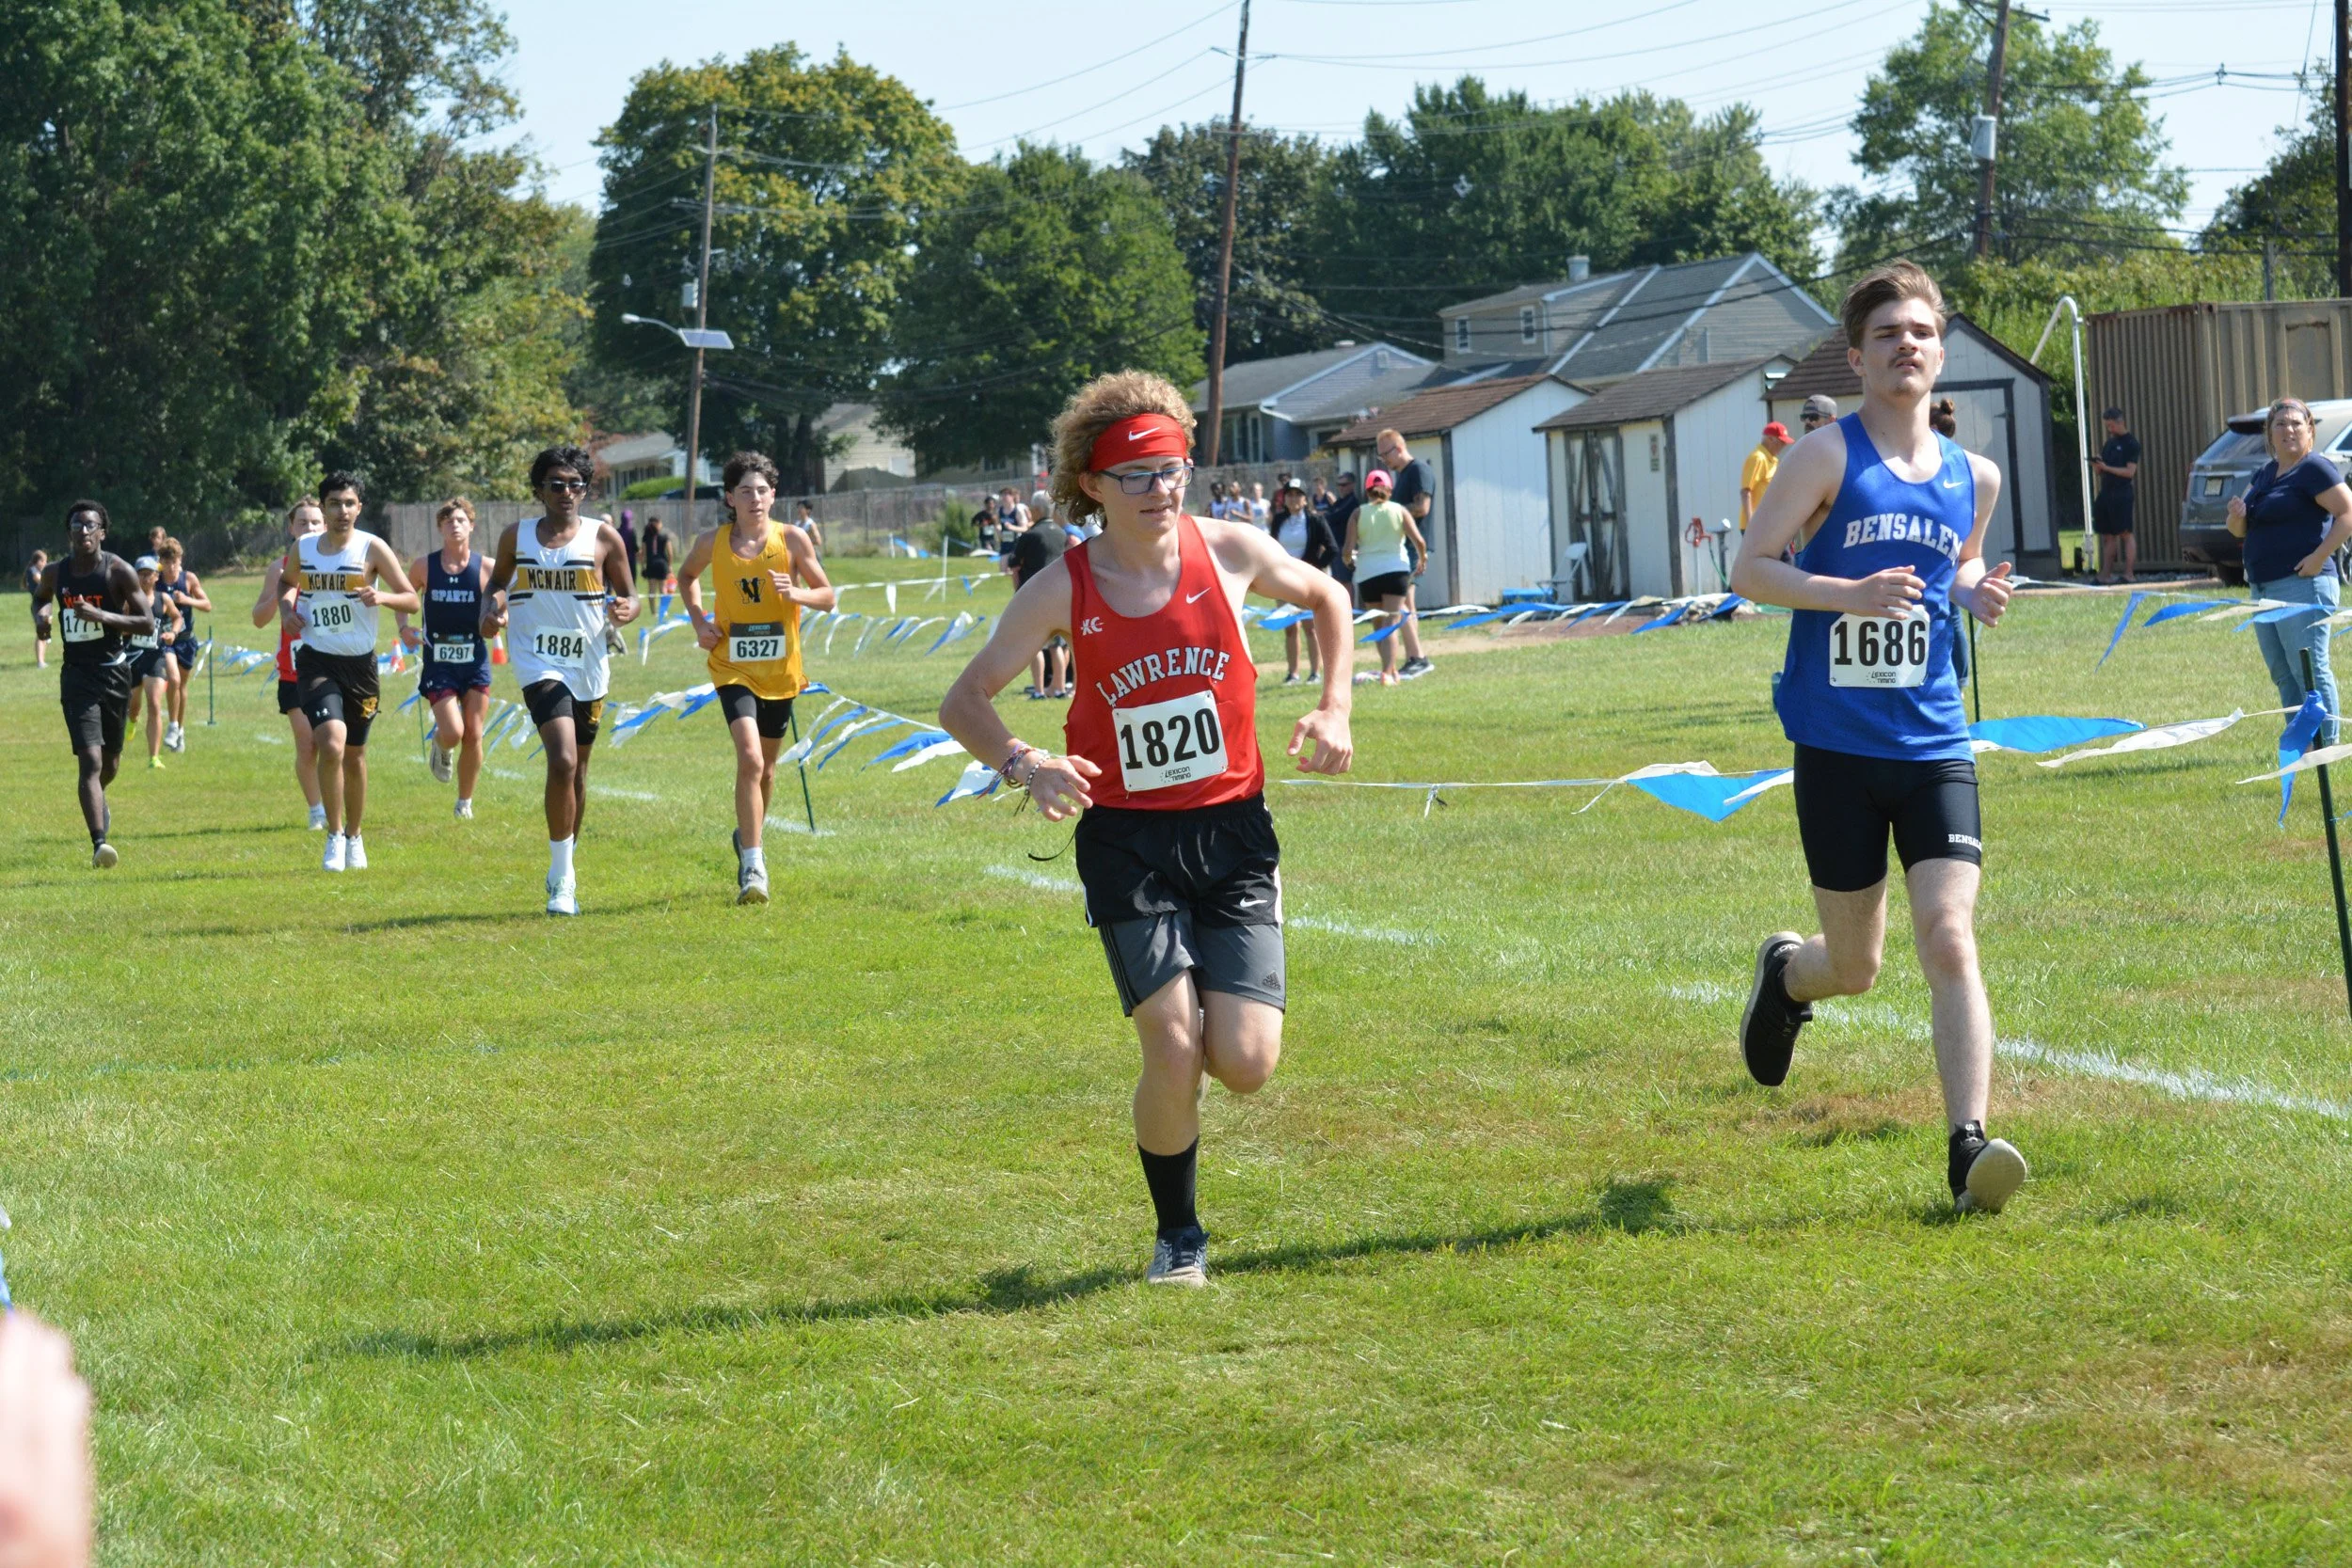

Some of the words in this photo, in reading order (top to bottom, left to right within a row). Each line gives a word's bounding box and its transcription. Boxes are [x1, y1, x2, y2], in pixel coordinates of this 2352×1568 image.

[308, 574, 347, 592] MCNAIR
[528, 569, 577, 590] MCNAIR
[431, 590, 475, 603] SPARTA
[312, 604, 351, 627] 1880
[439, 646, 470, 659] 6297
[535, 634, 583, 658] 1884
[737, 640, 779, 657] 6327
[1834, 620, 1926, 667] 1686
[1096, 646, 1231, 706] LAWRENCE
[1120, 707, 1220, 770] 1820
